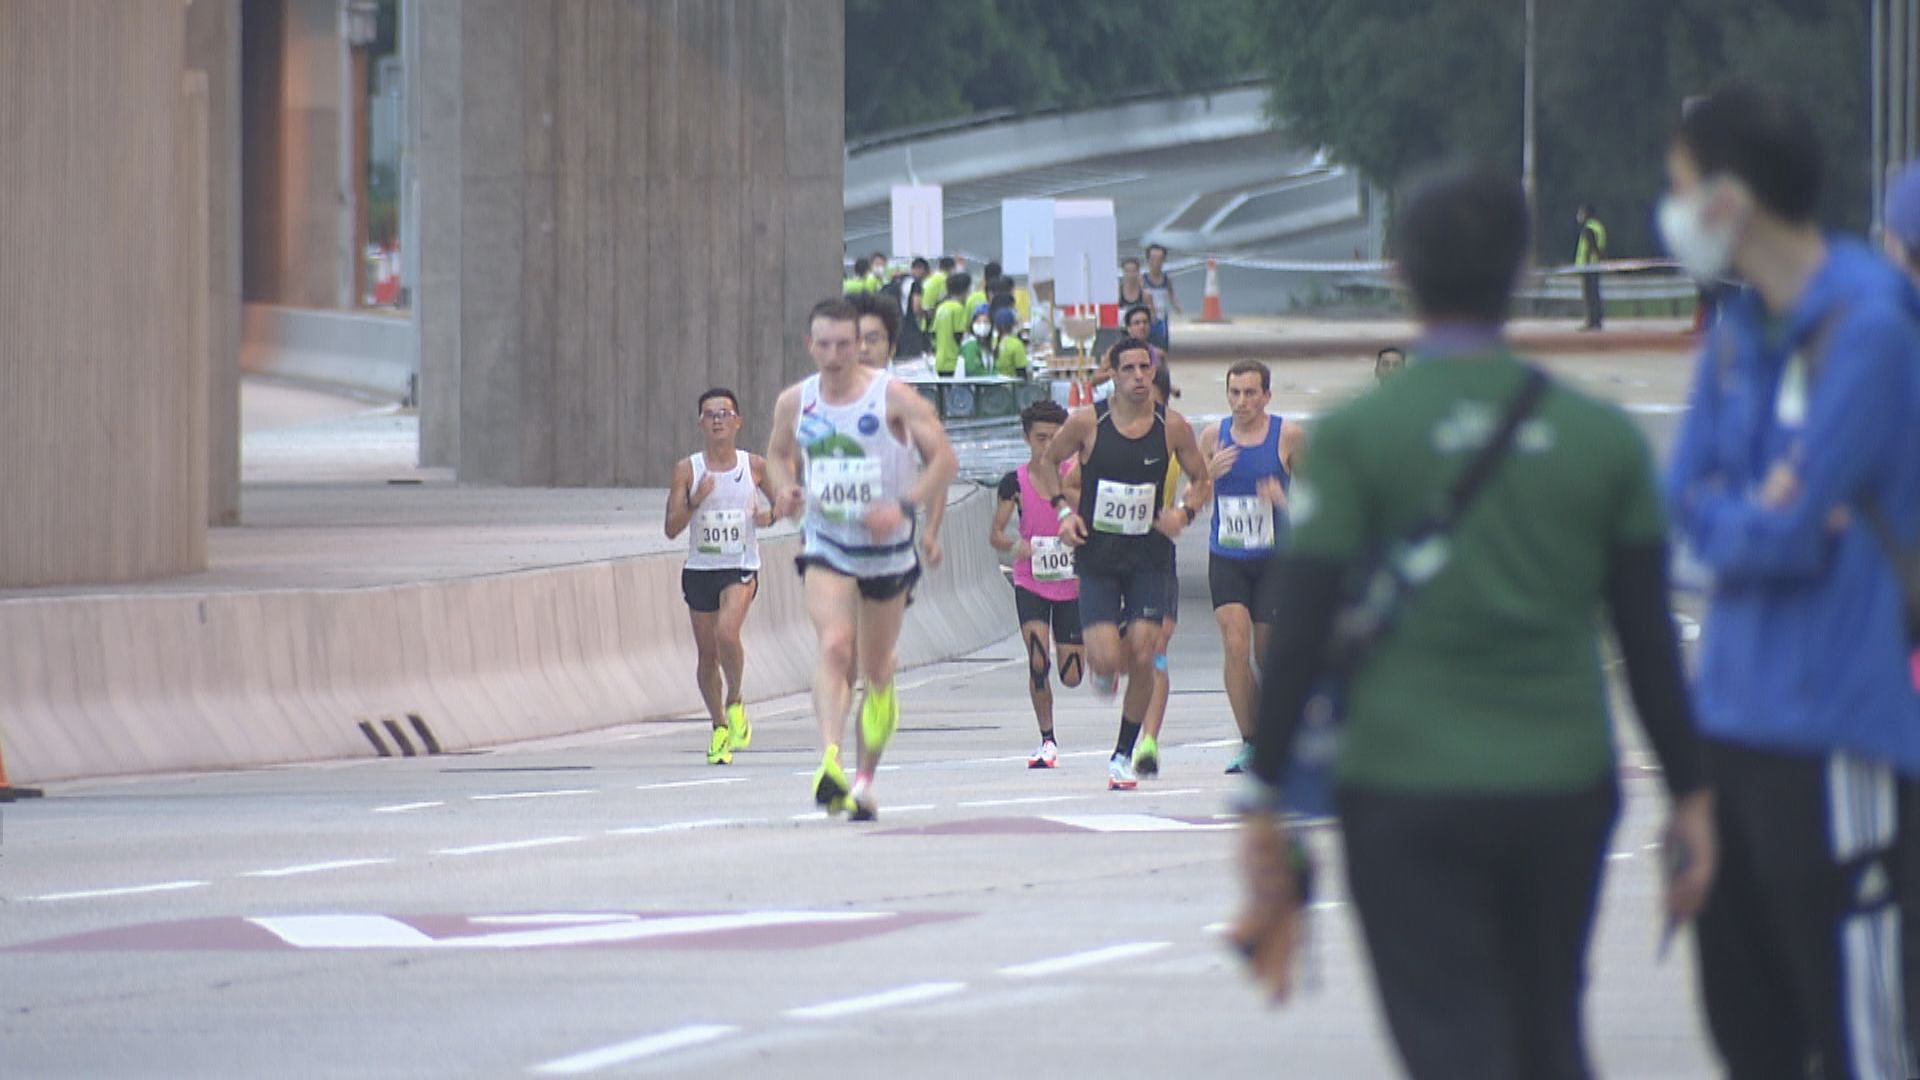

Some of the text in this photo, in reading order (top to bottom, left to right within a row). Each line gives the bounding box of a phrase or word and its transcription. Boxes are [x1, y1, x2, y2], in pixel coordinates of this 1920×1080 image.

[820, 483, 872, 503] 4048
[1104, 502, 1147, 521] 2019
[1226, 515, 1263, 534] 3017
[703, 527, 740, 542] 3019
